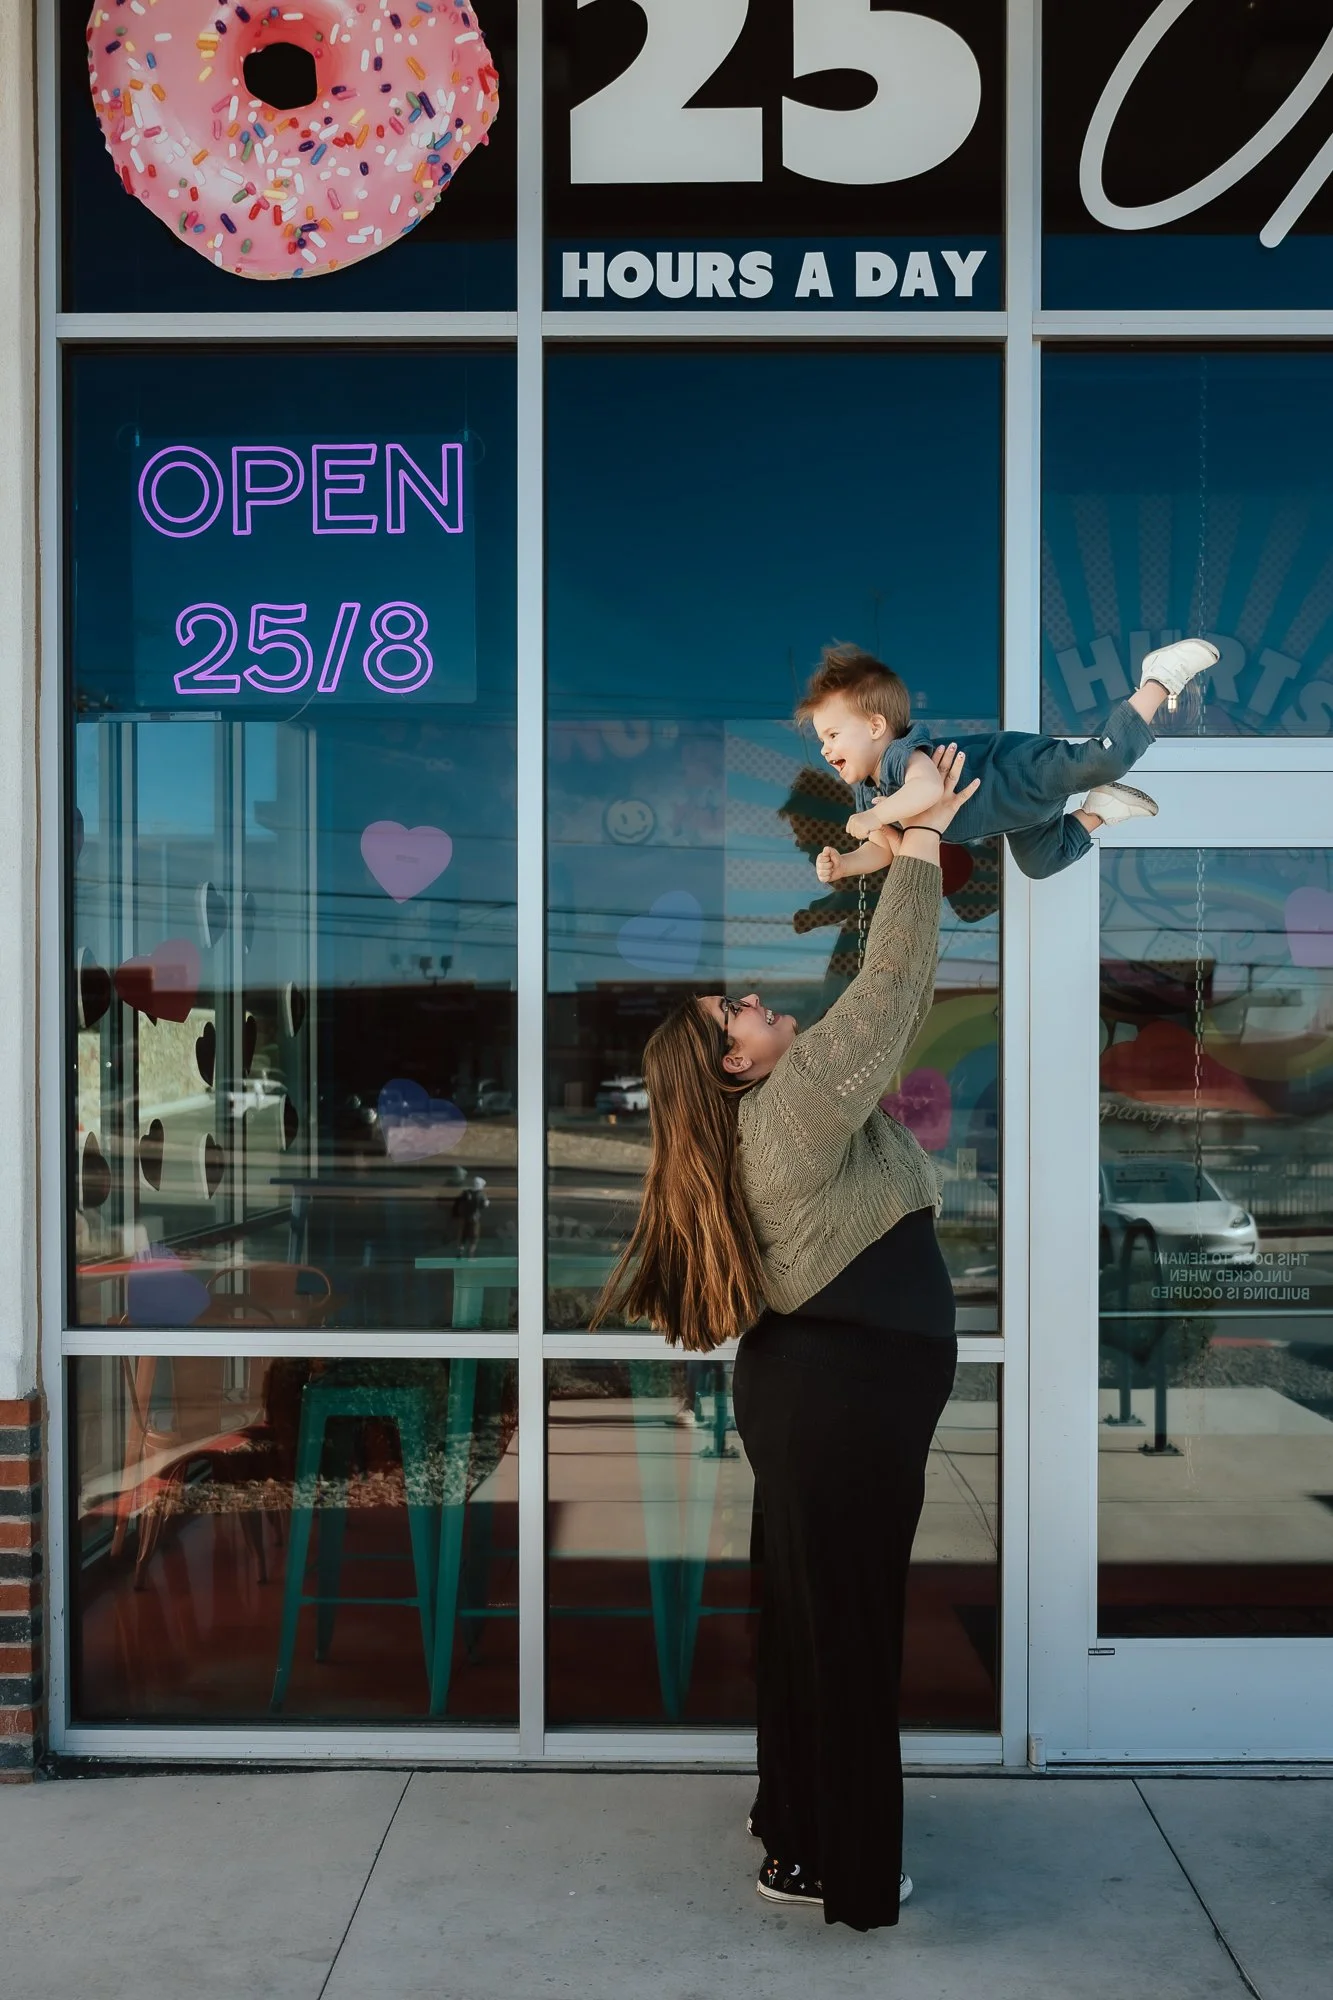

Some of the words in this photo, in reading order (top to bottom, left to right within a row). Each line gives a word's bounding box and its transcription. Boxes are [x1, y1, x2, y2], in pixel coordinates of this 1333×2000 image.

[570, 0, 981, 184] 25
[562, 250, 774, 299] HOURS
[795, 251, 834, 298] A
[856, 251, 987, 298] DAY
[138, 443, 463, 537] OPEN
[174, 601, 433, 694] 25/8
